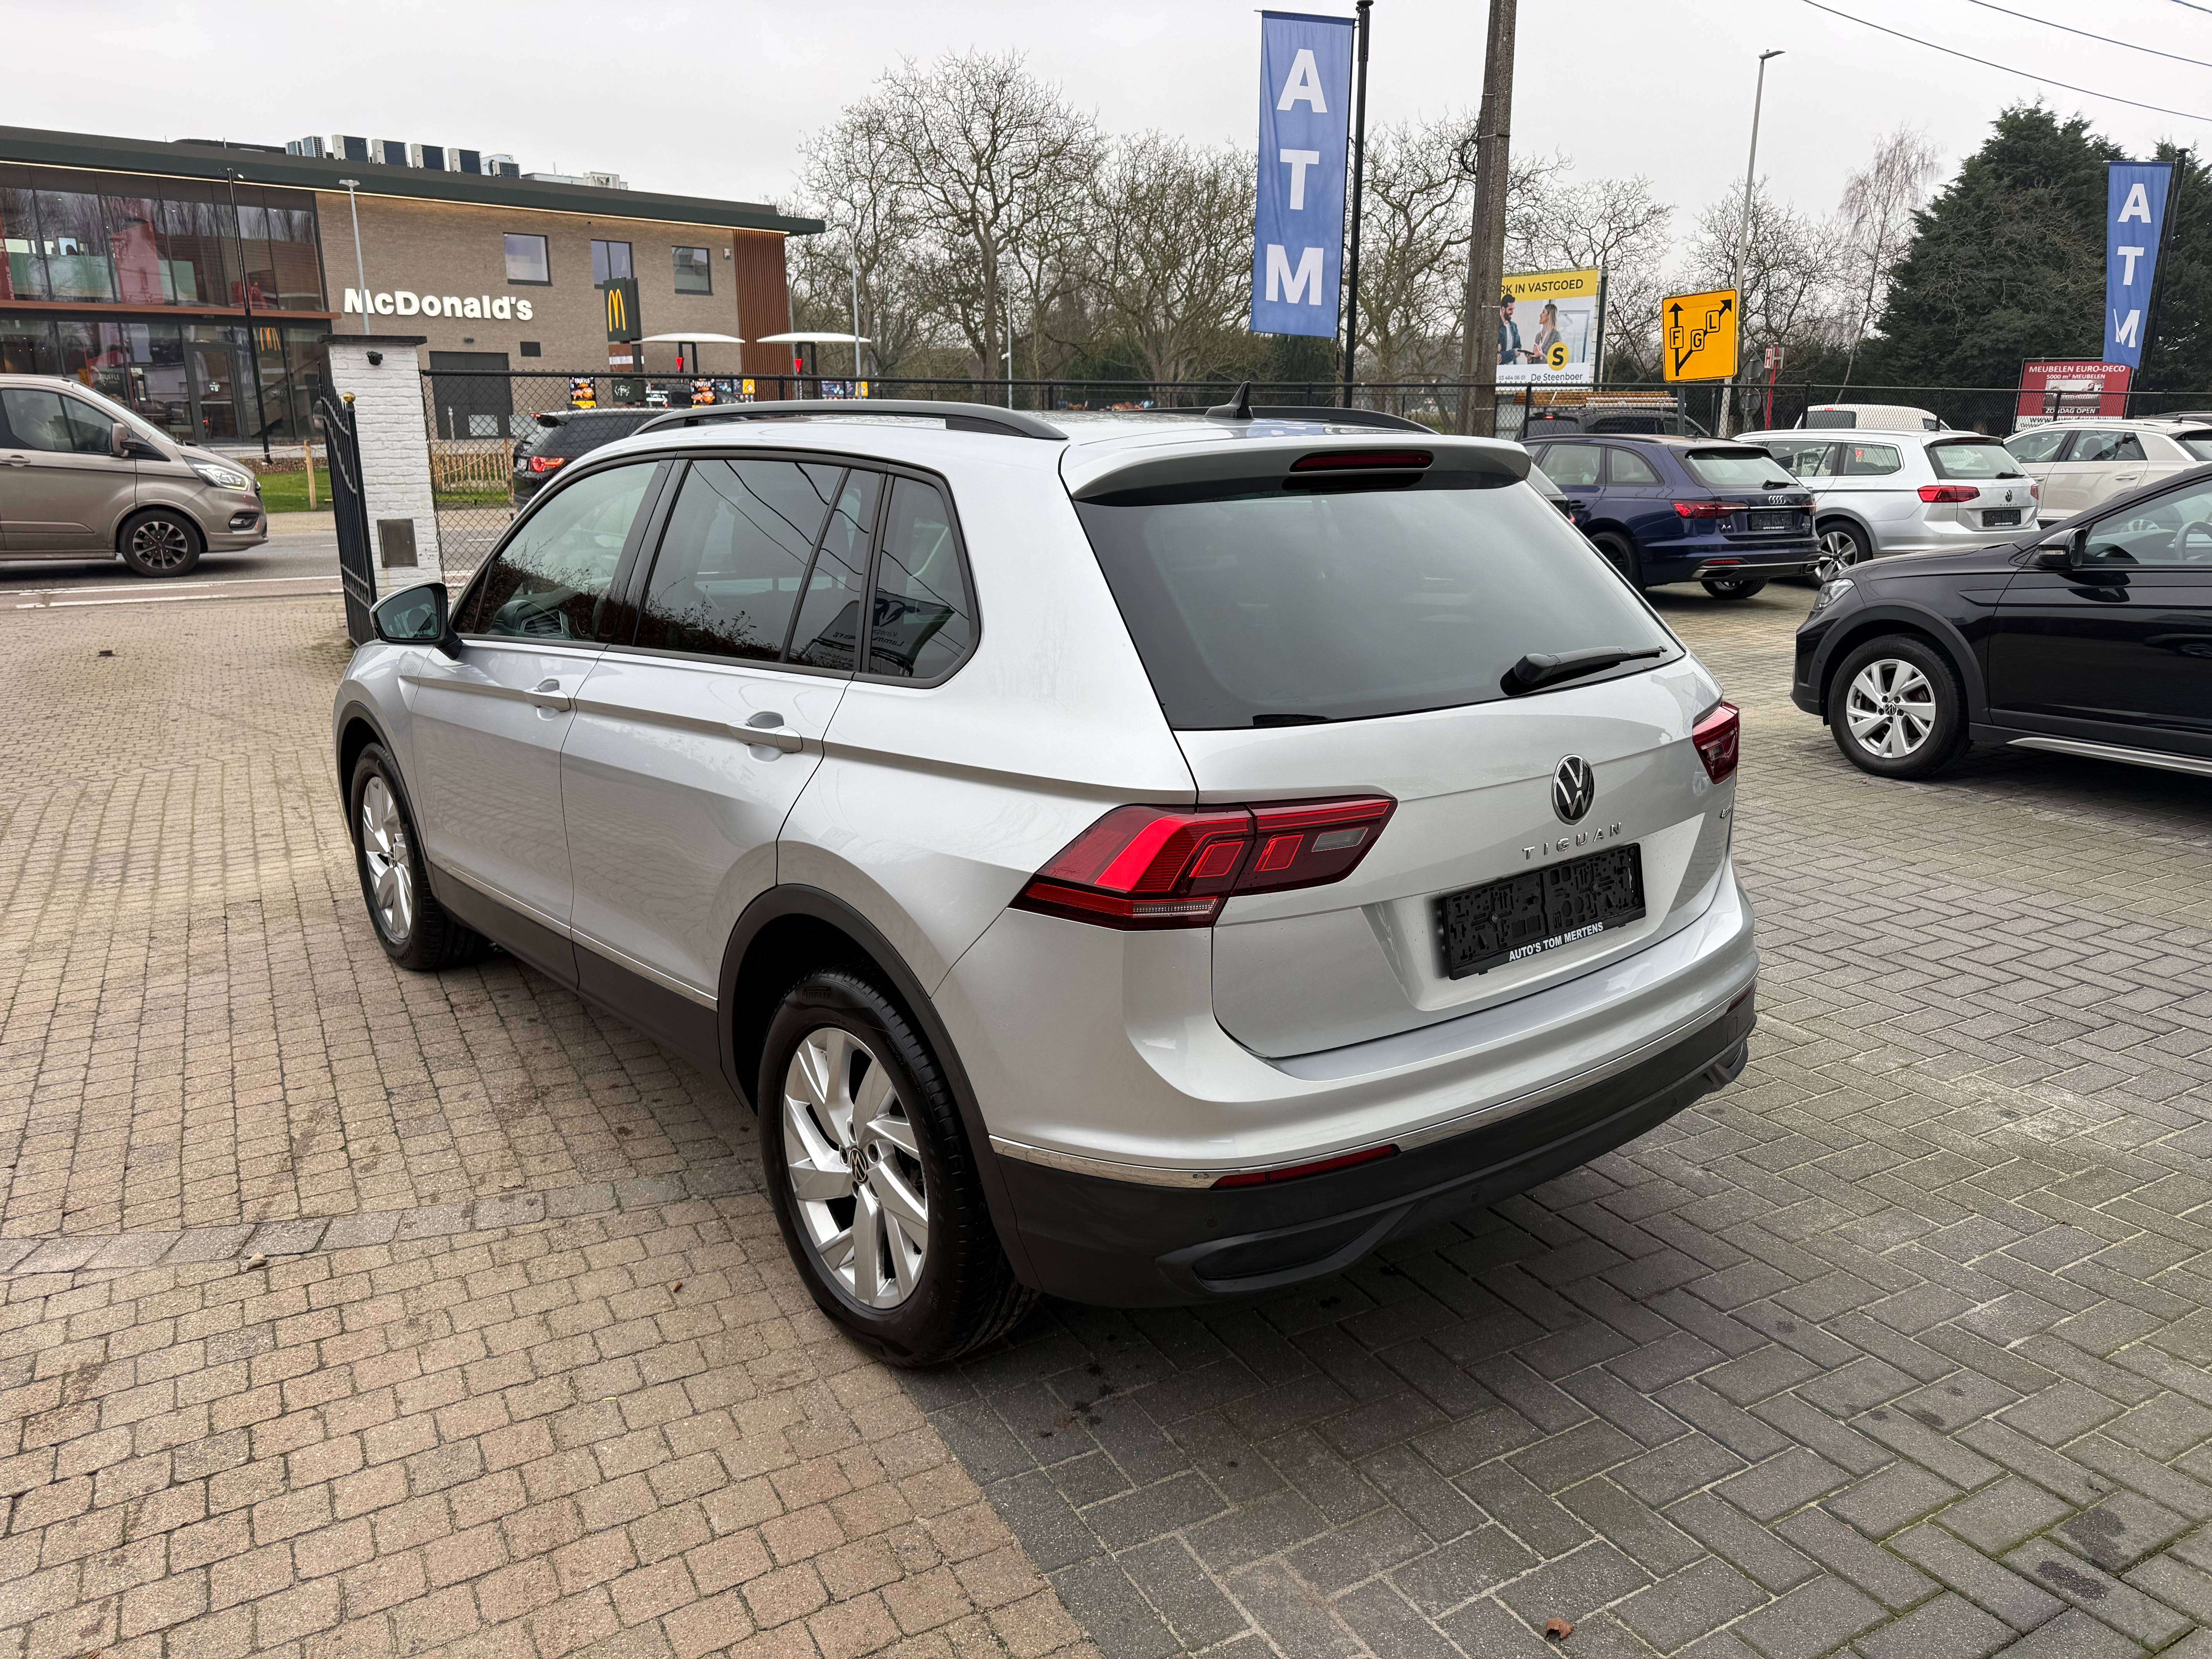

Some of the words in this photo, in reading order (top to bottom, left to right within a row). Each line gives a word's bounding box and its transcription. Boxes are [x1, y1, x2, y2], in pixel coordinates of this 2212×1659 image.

[1266, 49, 1327, 305] ATM
[2113, 183, 2151, 347] ATM
[1515, 283, 1525, 294] IN
[1528, 279, 1583, 292] VASTGOED
[344, 288, 533, 321] McDonald's
[1709, 314, 1717, 329] L
[1673, 330, 1680, 345] F
[1693, 333, 1702, 348] G
[1552, 347, 1564, 366] S
[1543, 372, 1583, 381] Steenboer
[1522, 822, 1621, 860] TIGUAN
[1509, 942, 1541, 962] AUTO'S
[1543, 935, 1562, 950] TOM
[1564, 922, 1603, 943] MERTENS
